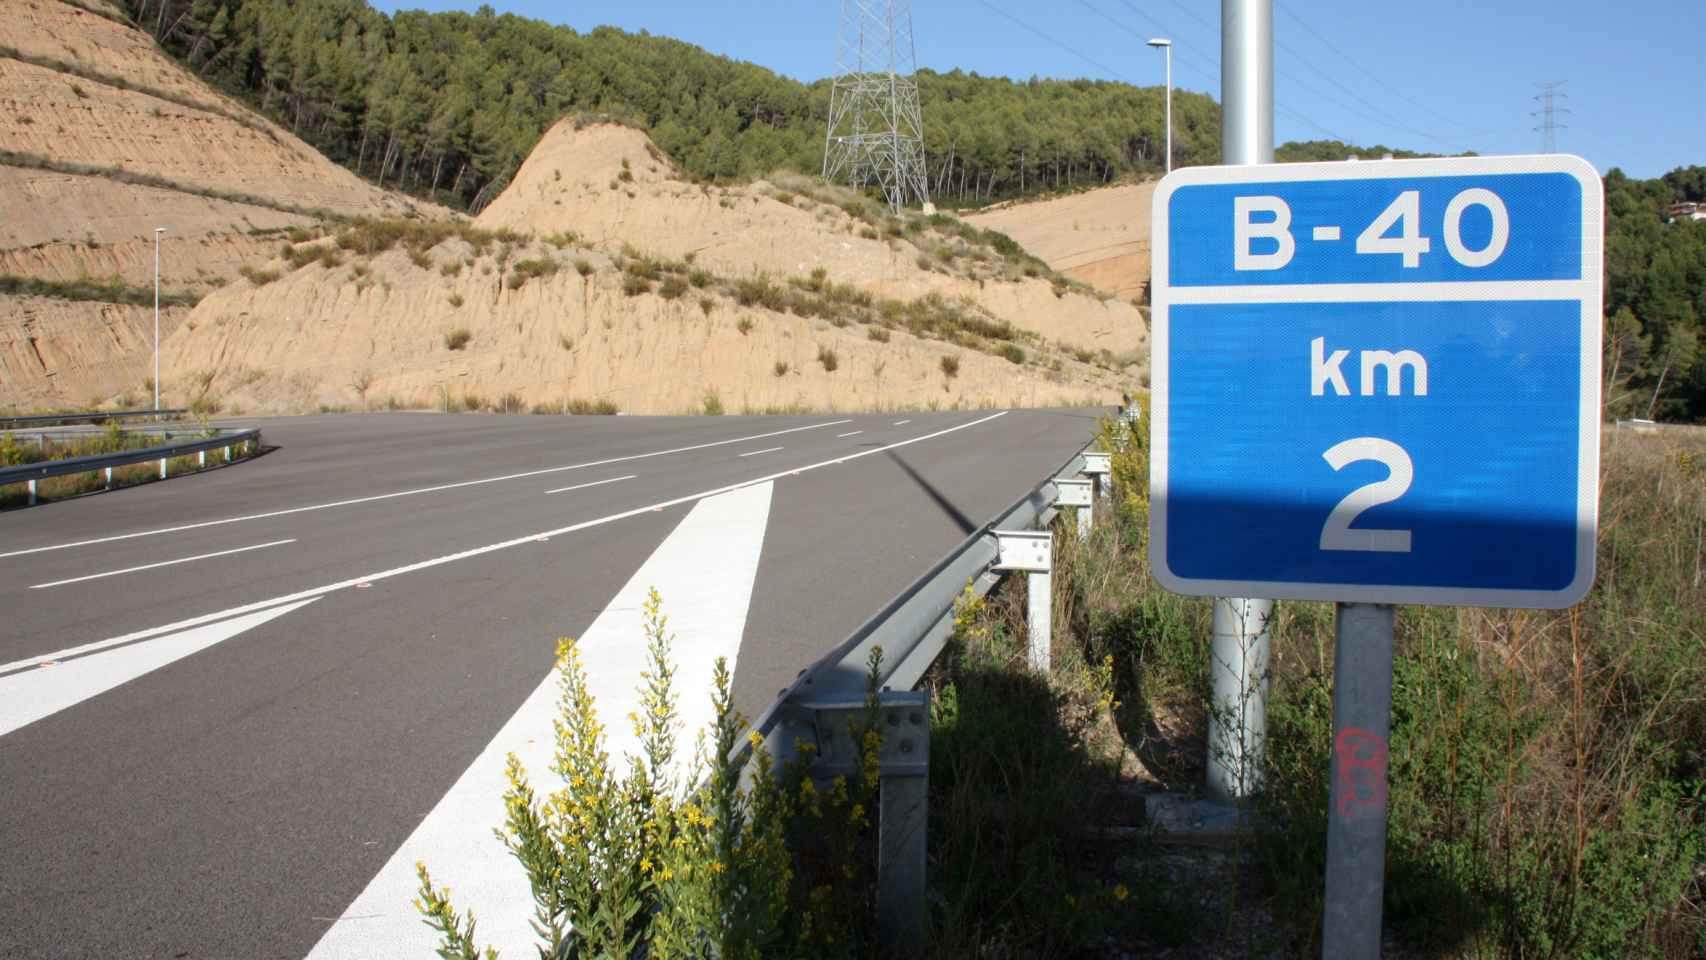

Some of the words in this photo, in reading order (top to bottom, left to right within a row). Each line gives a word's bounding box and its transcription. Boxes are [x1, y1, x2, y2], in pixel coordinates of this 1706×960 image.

[1233, 187, 1511, 272] B-40
[1310, 336, 1429, 397] km
[1319, 436, 1415, 553] 2
